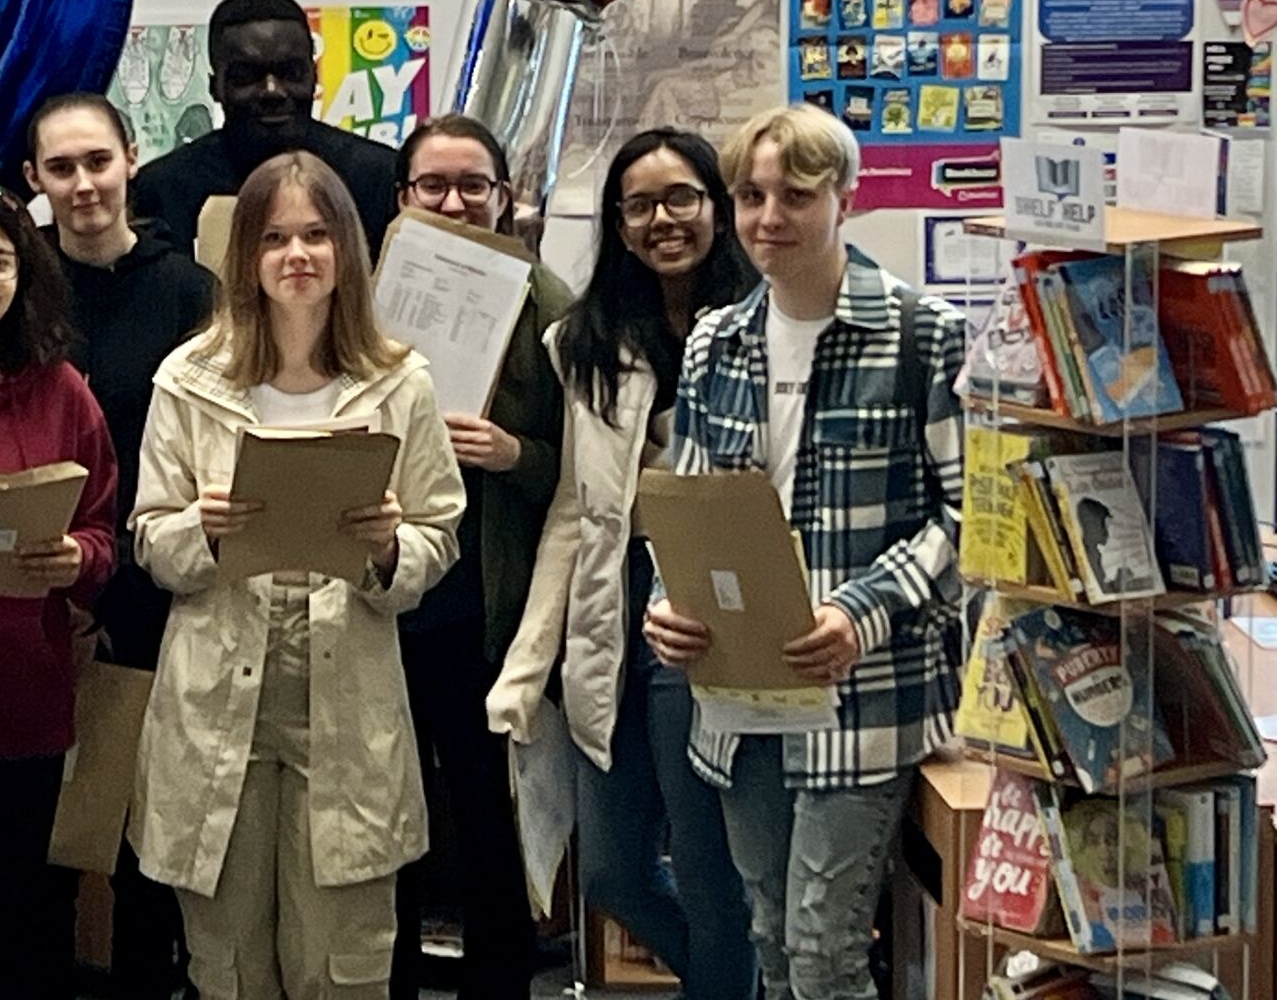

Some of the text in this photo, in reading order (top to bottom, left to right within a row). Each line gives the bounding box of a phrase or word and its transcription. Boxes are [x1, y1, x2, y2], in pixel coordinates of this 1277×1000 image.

[311, 57, 426, 127] AY
[1015, 196, 1055, 218] SHELF
[1062, 203, 1095, 224] HELP
[968, 856, 1032, 900] you
